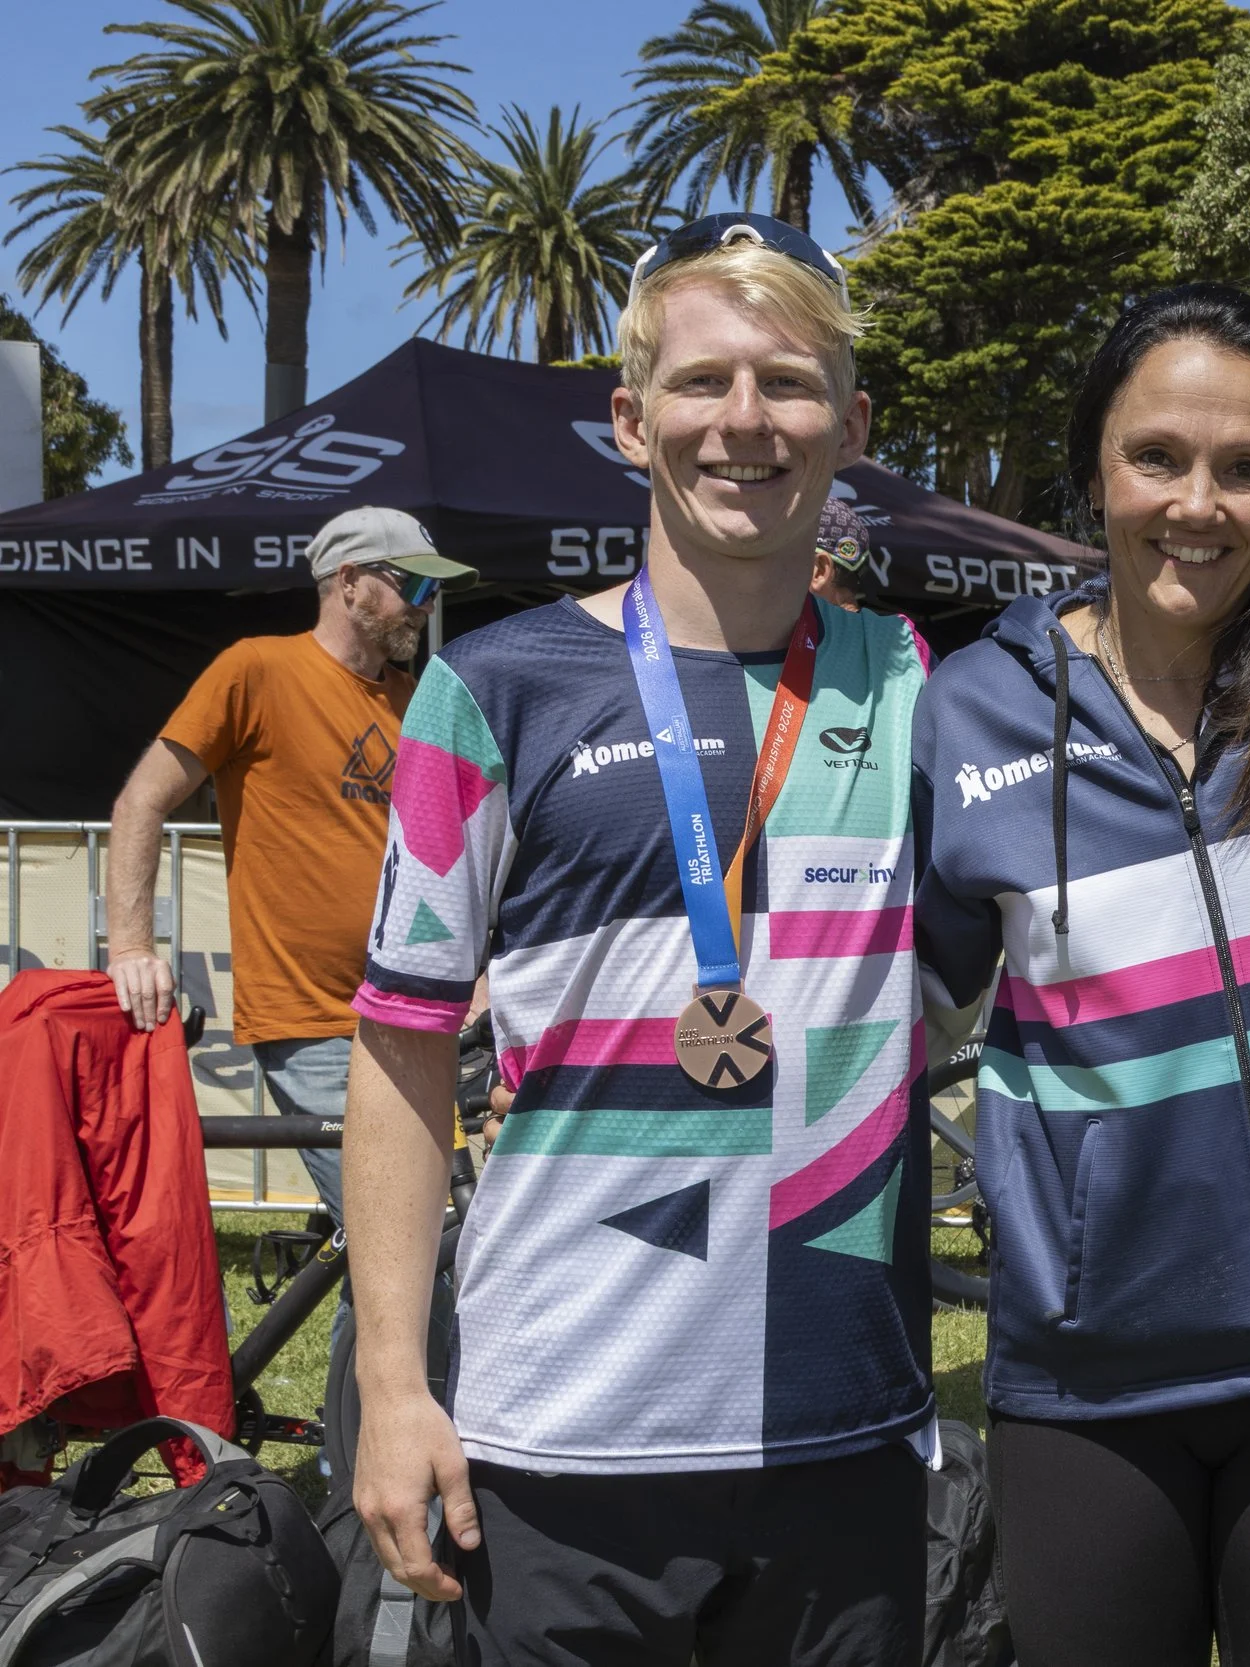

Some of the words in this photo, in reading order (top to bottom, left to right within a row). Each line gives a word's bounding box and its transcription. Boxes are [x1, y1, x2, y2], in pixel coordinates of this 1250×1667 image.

[256, 489, 334, 501] SPORT
[177, 536, 220, 570] IN
[924, 554, 1077, 601] SPORT
[641, 631, 660, 662] 2026
[779, 700, 795, 733] 2026
[756, 733, 785, 794] Australian
[823, 758, 879, 771] VENTOU
[691, 813, 714, 885] TRIATHLON
[688, 858, 703, 885] AUS
[678, 1028, 700, 1041] AUS
[678, 1034, 735, 1049] TRIATHLON
